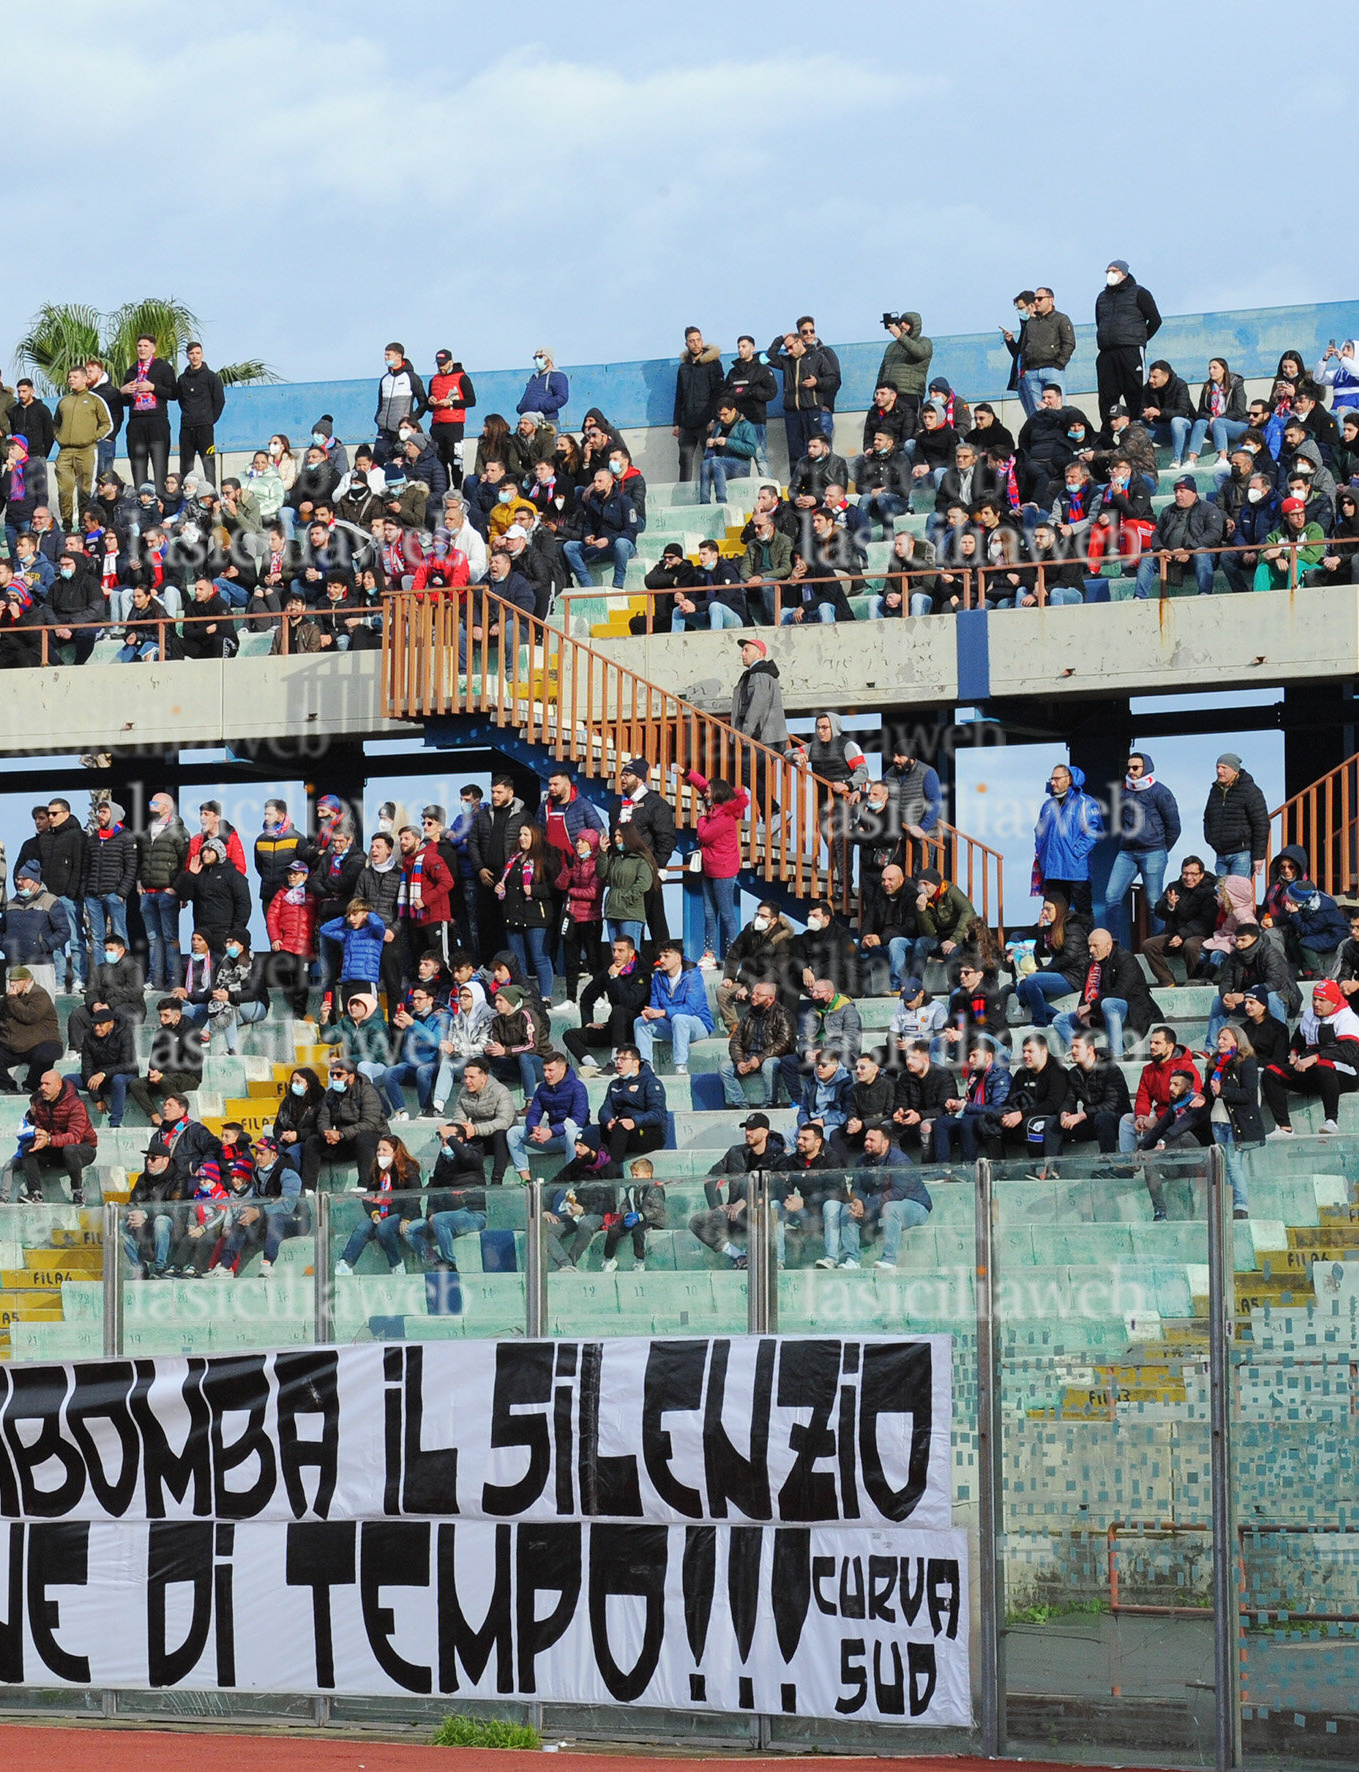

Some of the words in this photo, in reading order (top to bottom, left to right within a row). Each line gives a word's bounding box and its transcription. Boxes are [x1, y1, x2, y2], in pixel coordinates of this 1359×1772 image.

[285, 1520, 811, 1711] TEMPO!!!
[812, 1555, 960, 1640] CURVA
[834, 1638, 938, 1717] SUD
